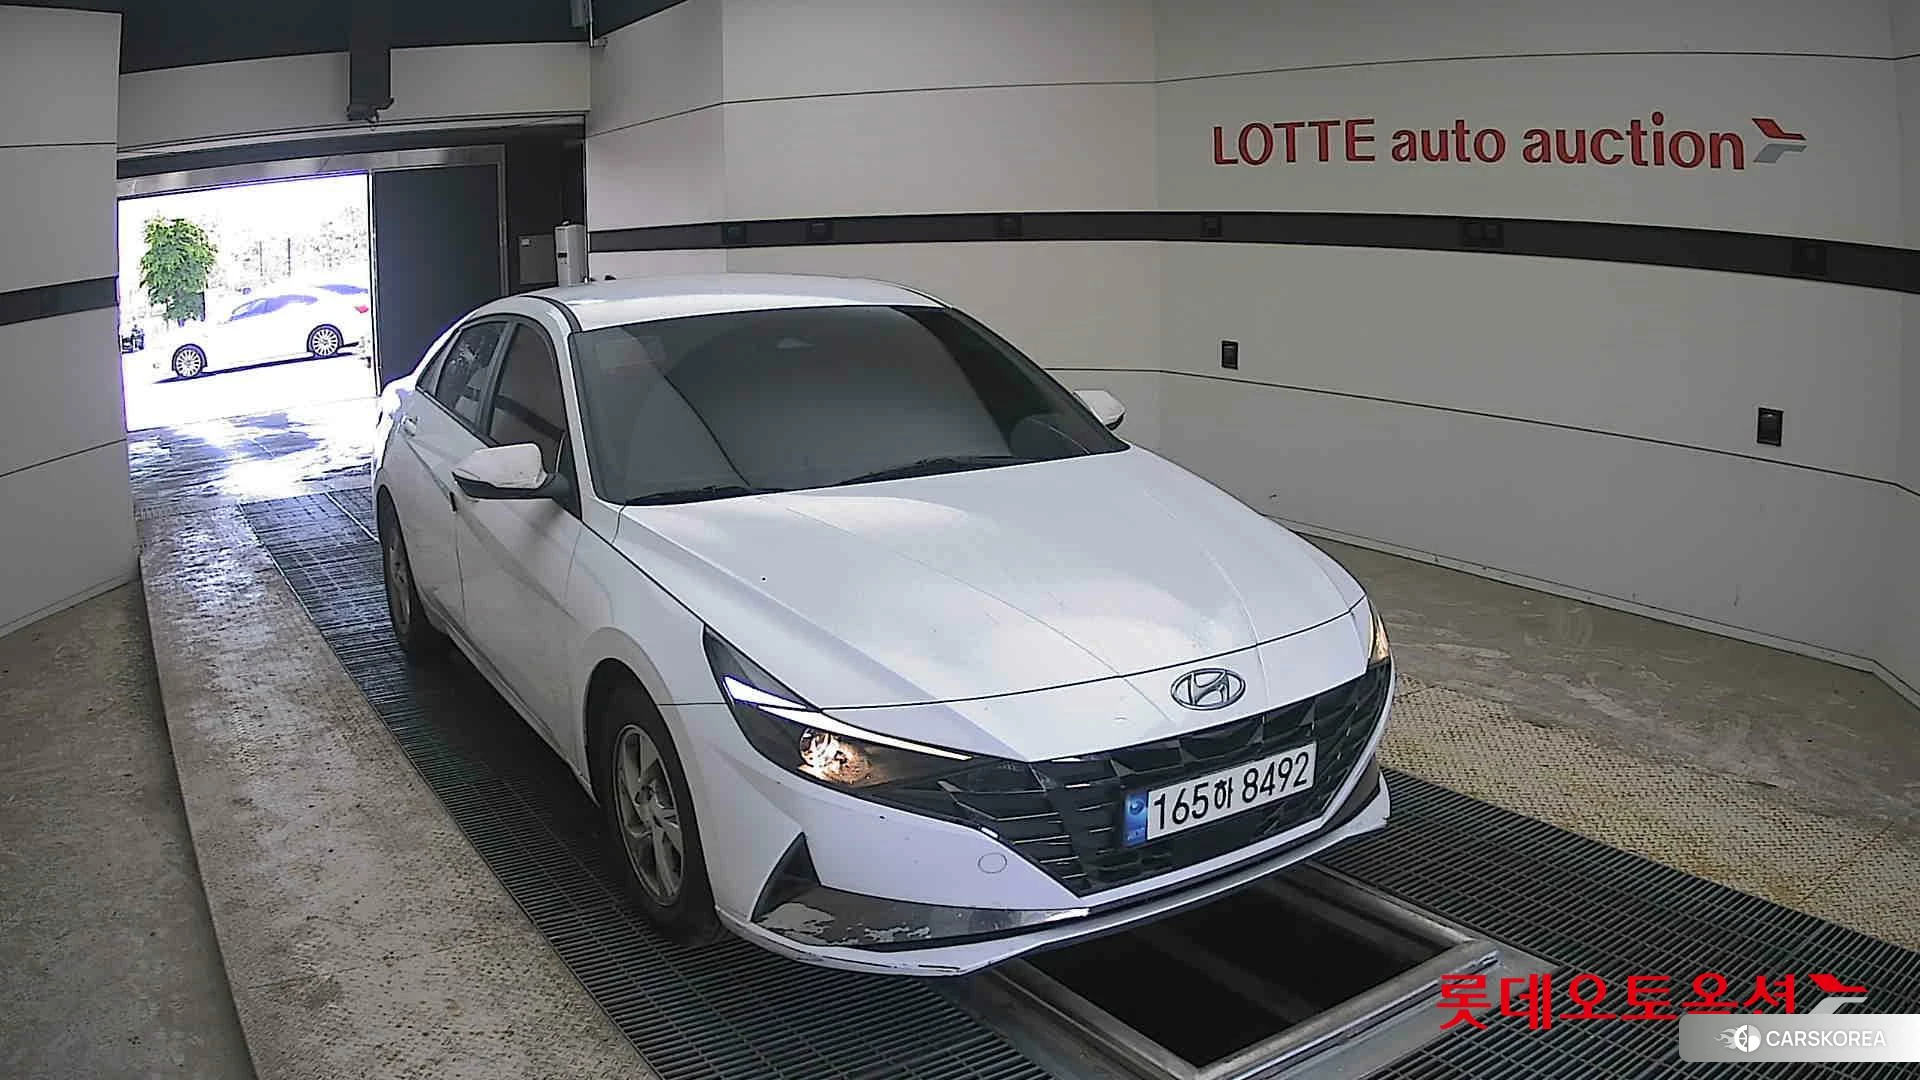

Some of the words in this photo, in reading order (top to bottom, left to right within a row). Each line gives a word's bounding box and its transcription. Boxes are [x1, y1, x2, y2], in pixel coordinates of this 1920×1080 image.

[1212, 118, 1376, 165] LOTTE
[1391, 119, 1506, 163] auto
[1522, 111, 1745, 170] auction
[1154, 776, 1233, 829] 165하
[1241, 751, 1309, 803] 8492
